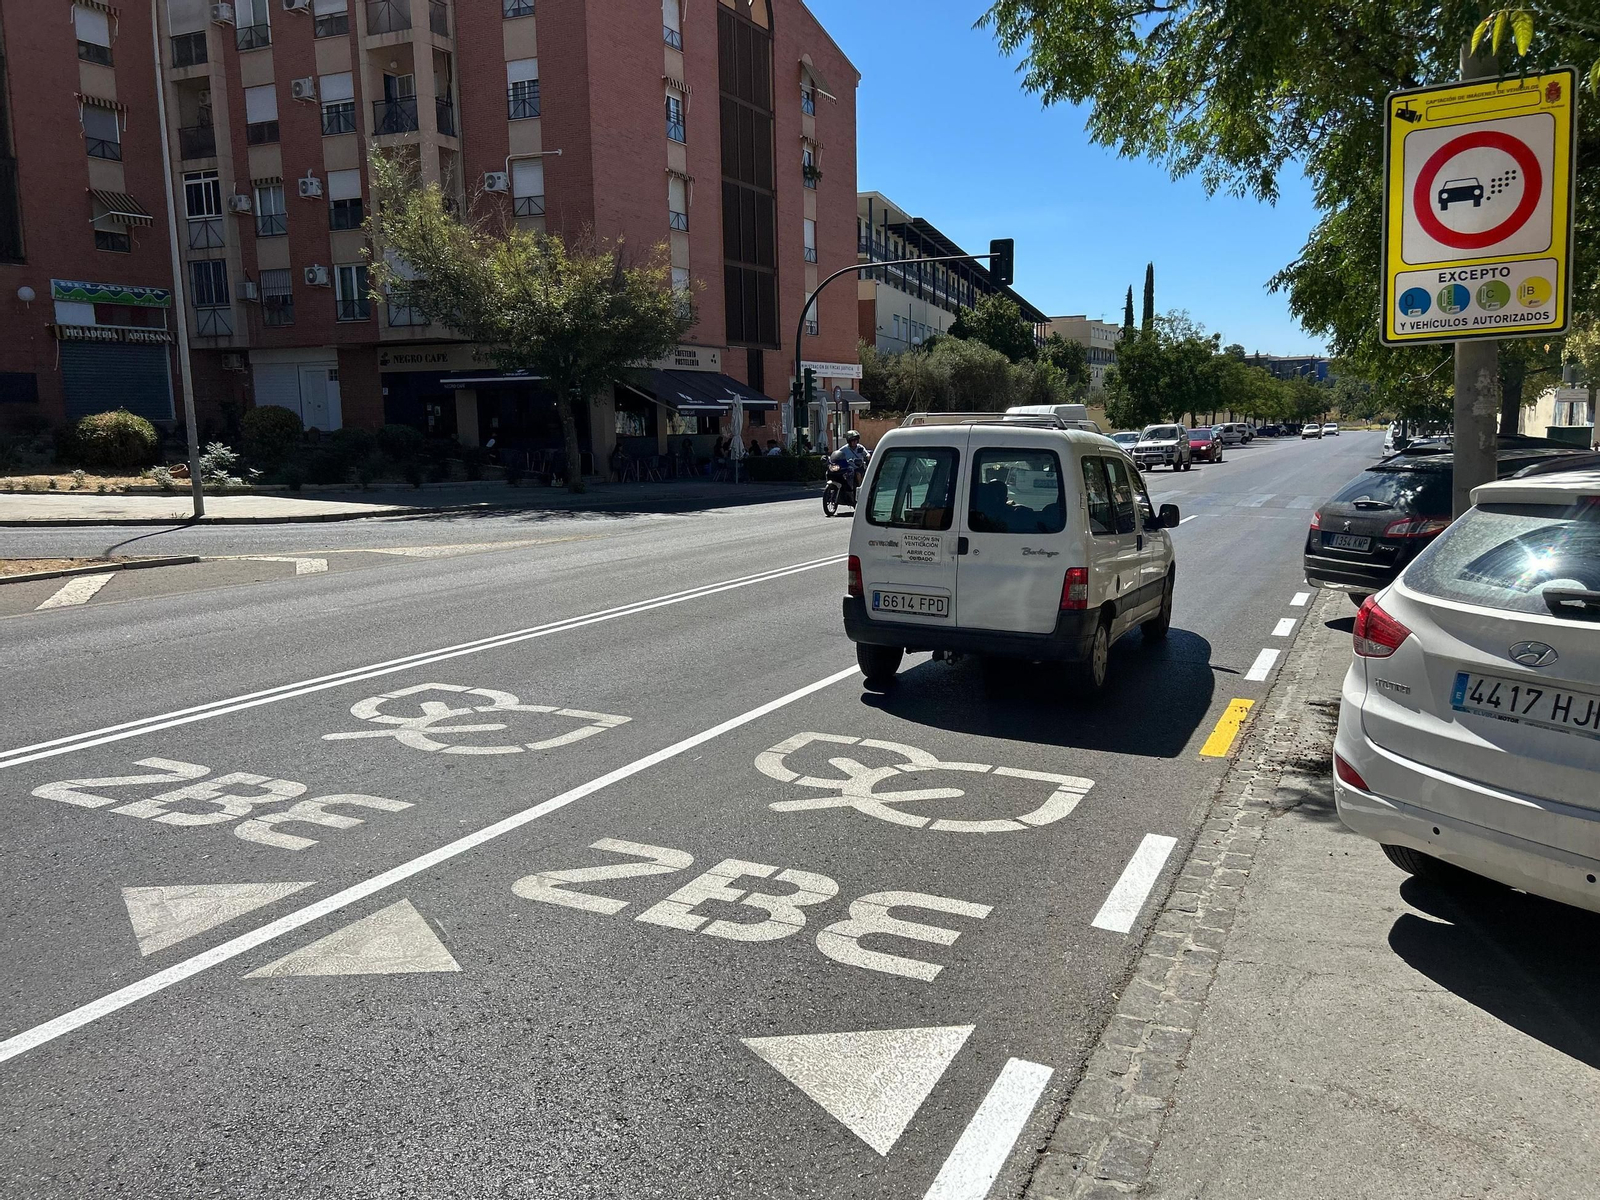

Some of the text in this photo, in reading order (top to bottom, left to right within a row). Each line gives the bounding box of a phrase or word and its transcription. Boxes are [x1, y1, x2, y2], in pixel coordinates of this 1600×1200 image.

[1425, 95, 1457, 106] CAPTACIÓN
[1466, 90, 1497, 100] IMÁGENES
[1438, 266, 1511, 284] EXCEPTO
[1485, 289, 1495, 299] C
[1526, 286, 1535, 295] B
[1400, 311, 1551, 331] Y VEHÍCULOS AUTORIZADOS
[128, 332, 172, 342] ARTESANA
[393, 352, 449, 365] NEGRO CAFÉ
[1335, 535, 1351, 547] 1354
[1021, 546, 1060, 559] Berlingo
[883, 594, 944, 612] 6614 FPD
[1455, 691, 1463, 700] E
[1469, 679, 1543, 715] 4417
[31, 756, 414, 851] ZBE
[511, 837, 994, 982] ZBE
